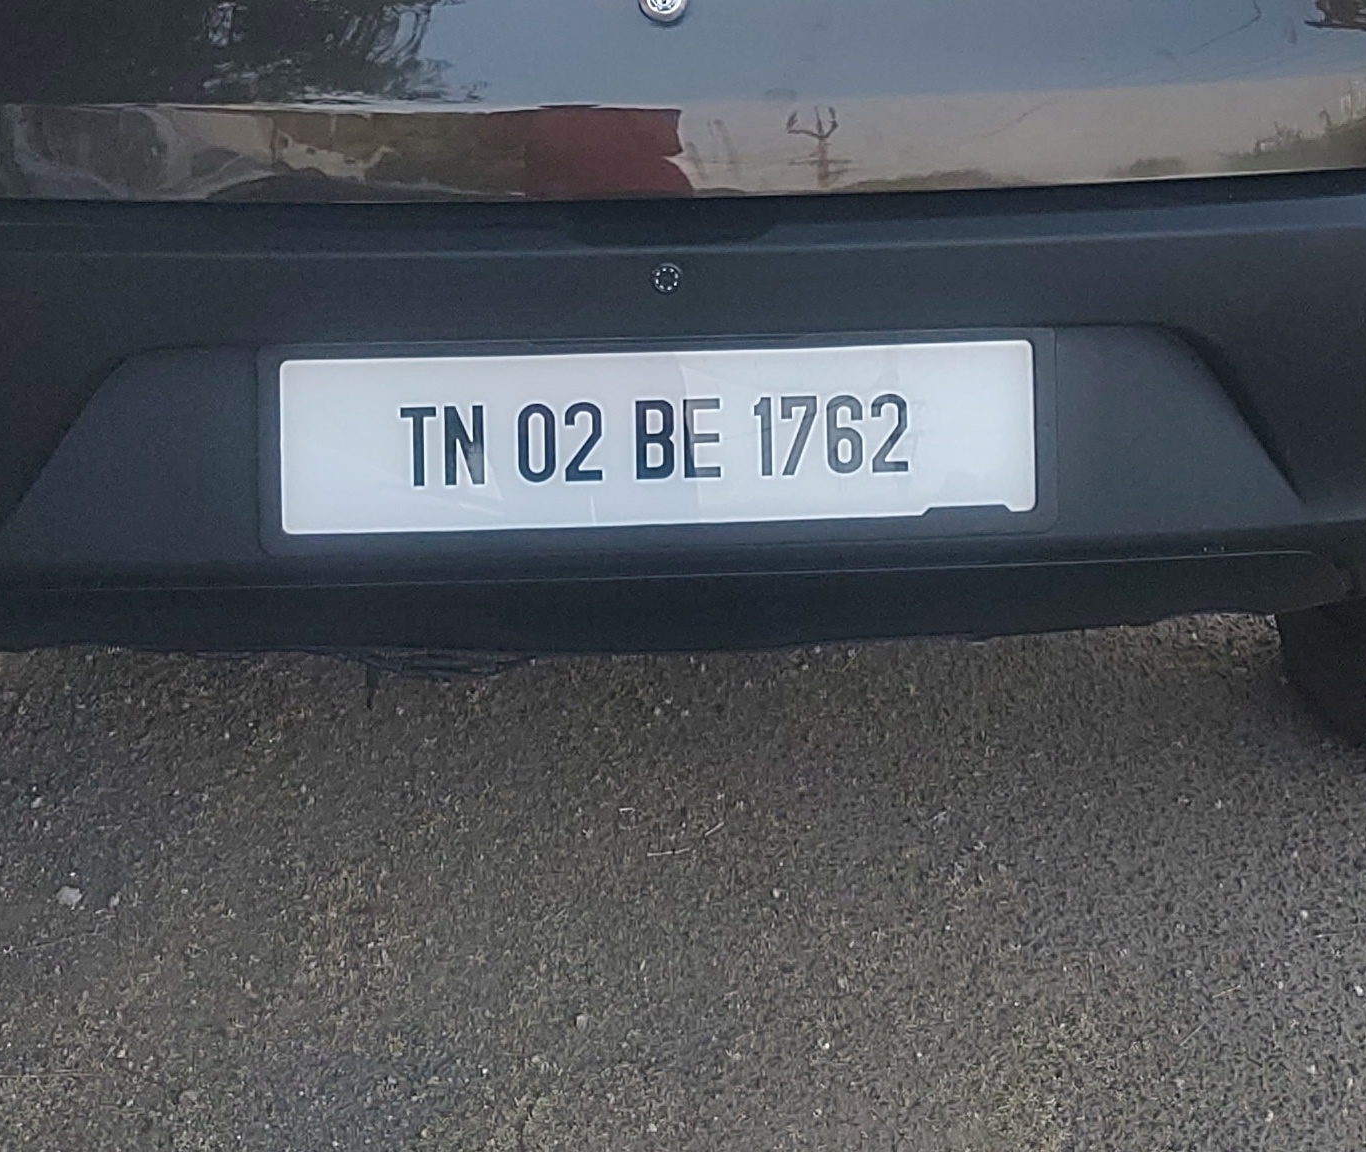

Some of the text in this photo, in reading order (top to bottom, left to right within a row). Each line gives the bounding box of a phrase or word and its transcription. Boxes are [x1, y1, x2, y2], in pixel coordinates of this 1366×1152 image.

[399, 393, 909, 487] TN 02 BE 1762
